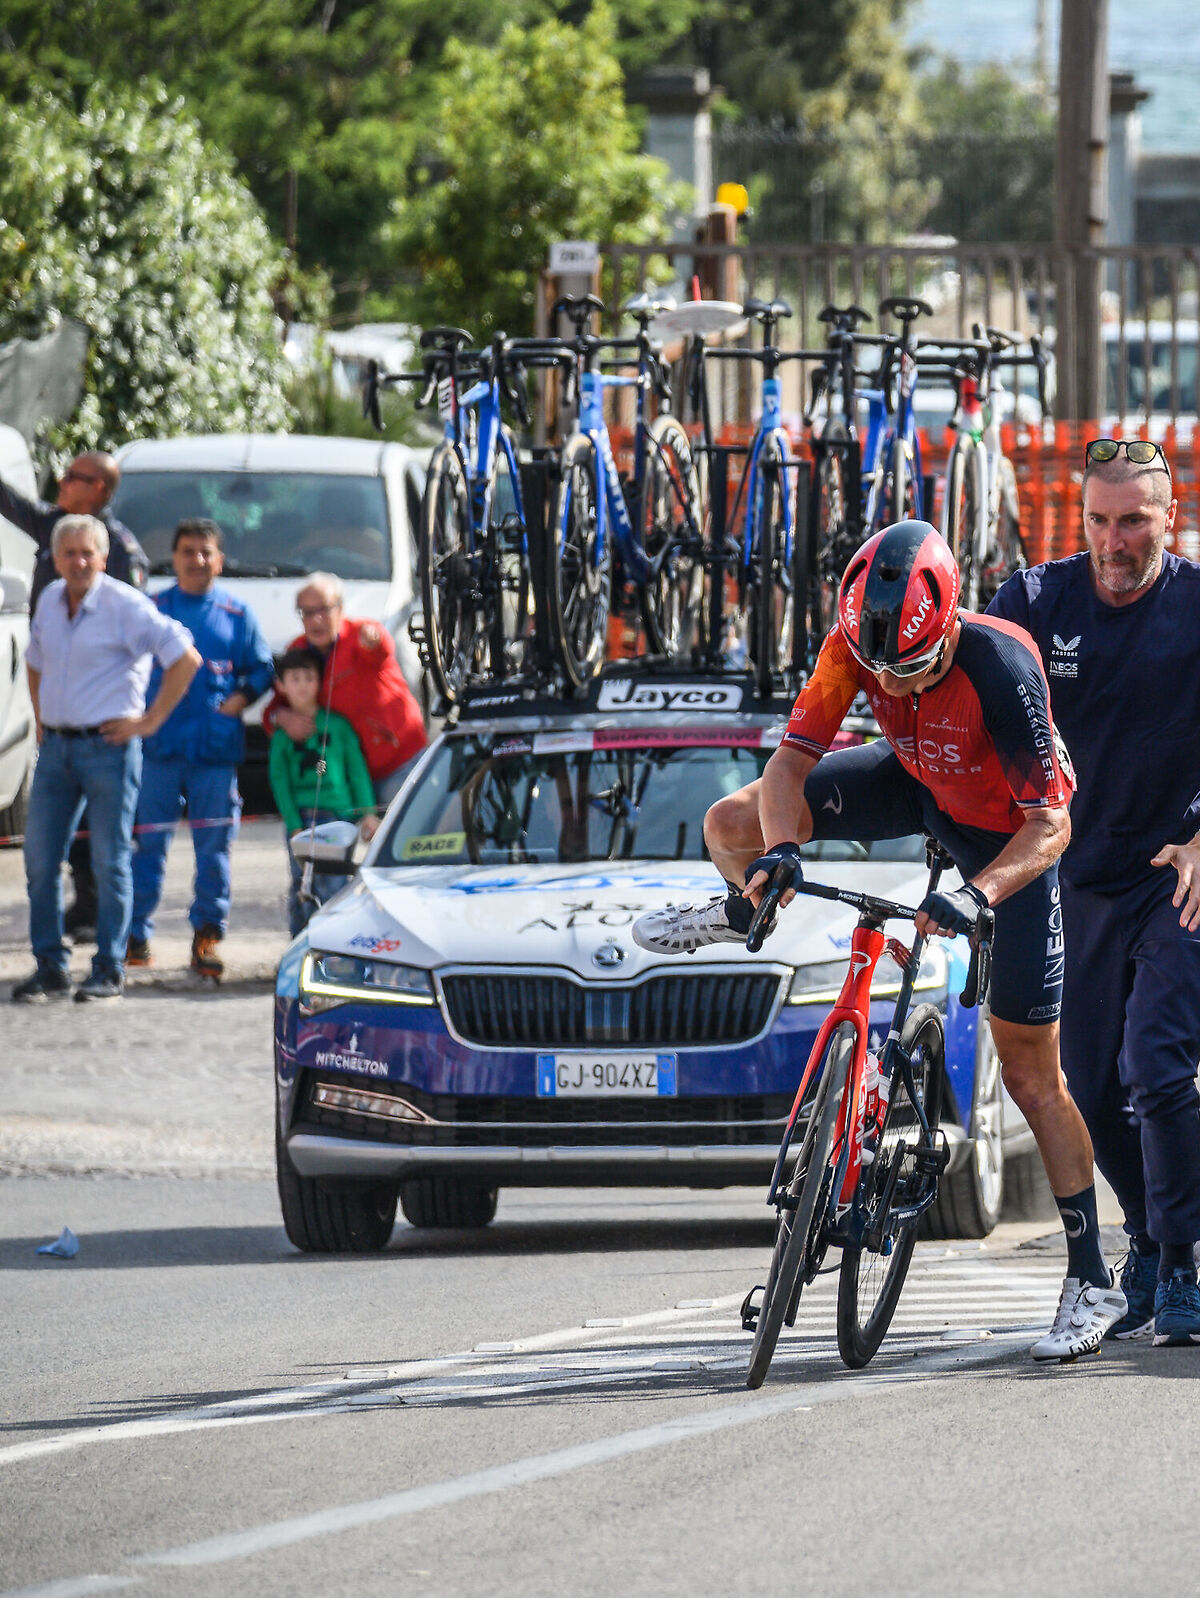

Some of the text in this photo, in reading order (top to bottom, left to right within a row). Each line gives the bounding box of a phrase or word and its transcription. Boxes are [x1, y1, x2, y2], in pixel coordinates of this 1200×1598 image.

[902, 594, 933, 640] KASK
[1050, 661, 1078, 671] INEOS
[611, 682, 728, 710] Jayco
[1016, 683, 1056, 782] GRENADIER
[894, 736, 961, 764] EOS
[411, 837, 457, 852] RACE
[1043, 884, 1065, 990] INEOS
[314, 1051, 388, 1077] MITCHELTON
